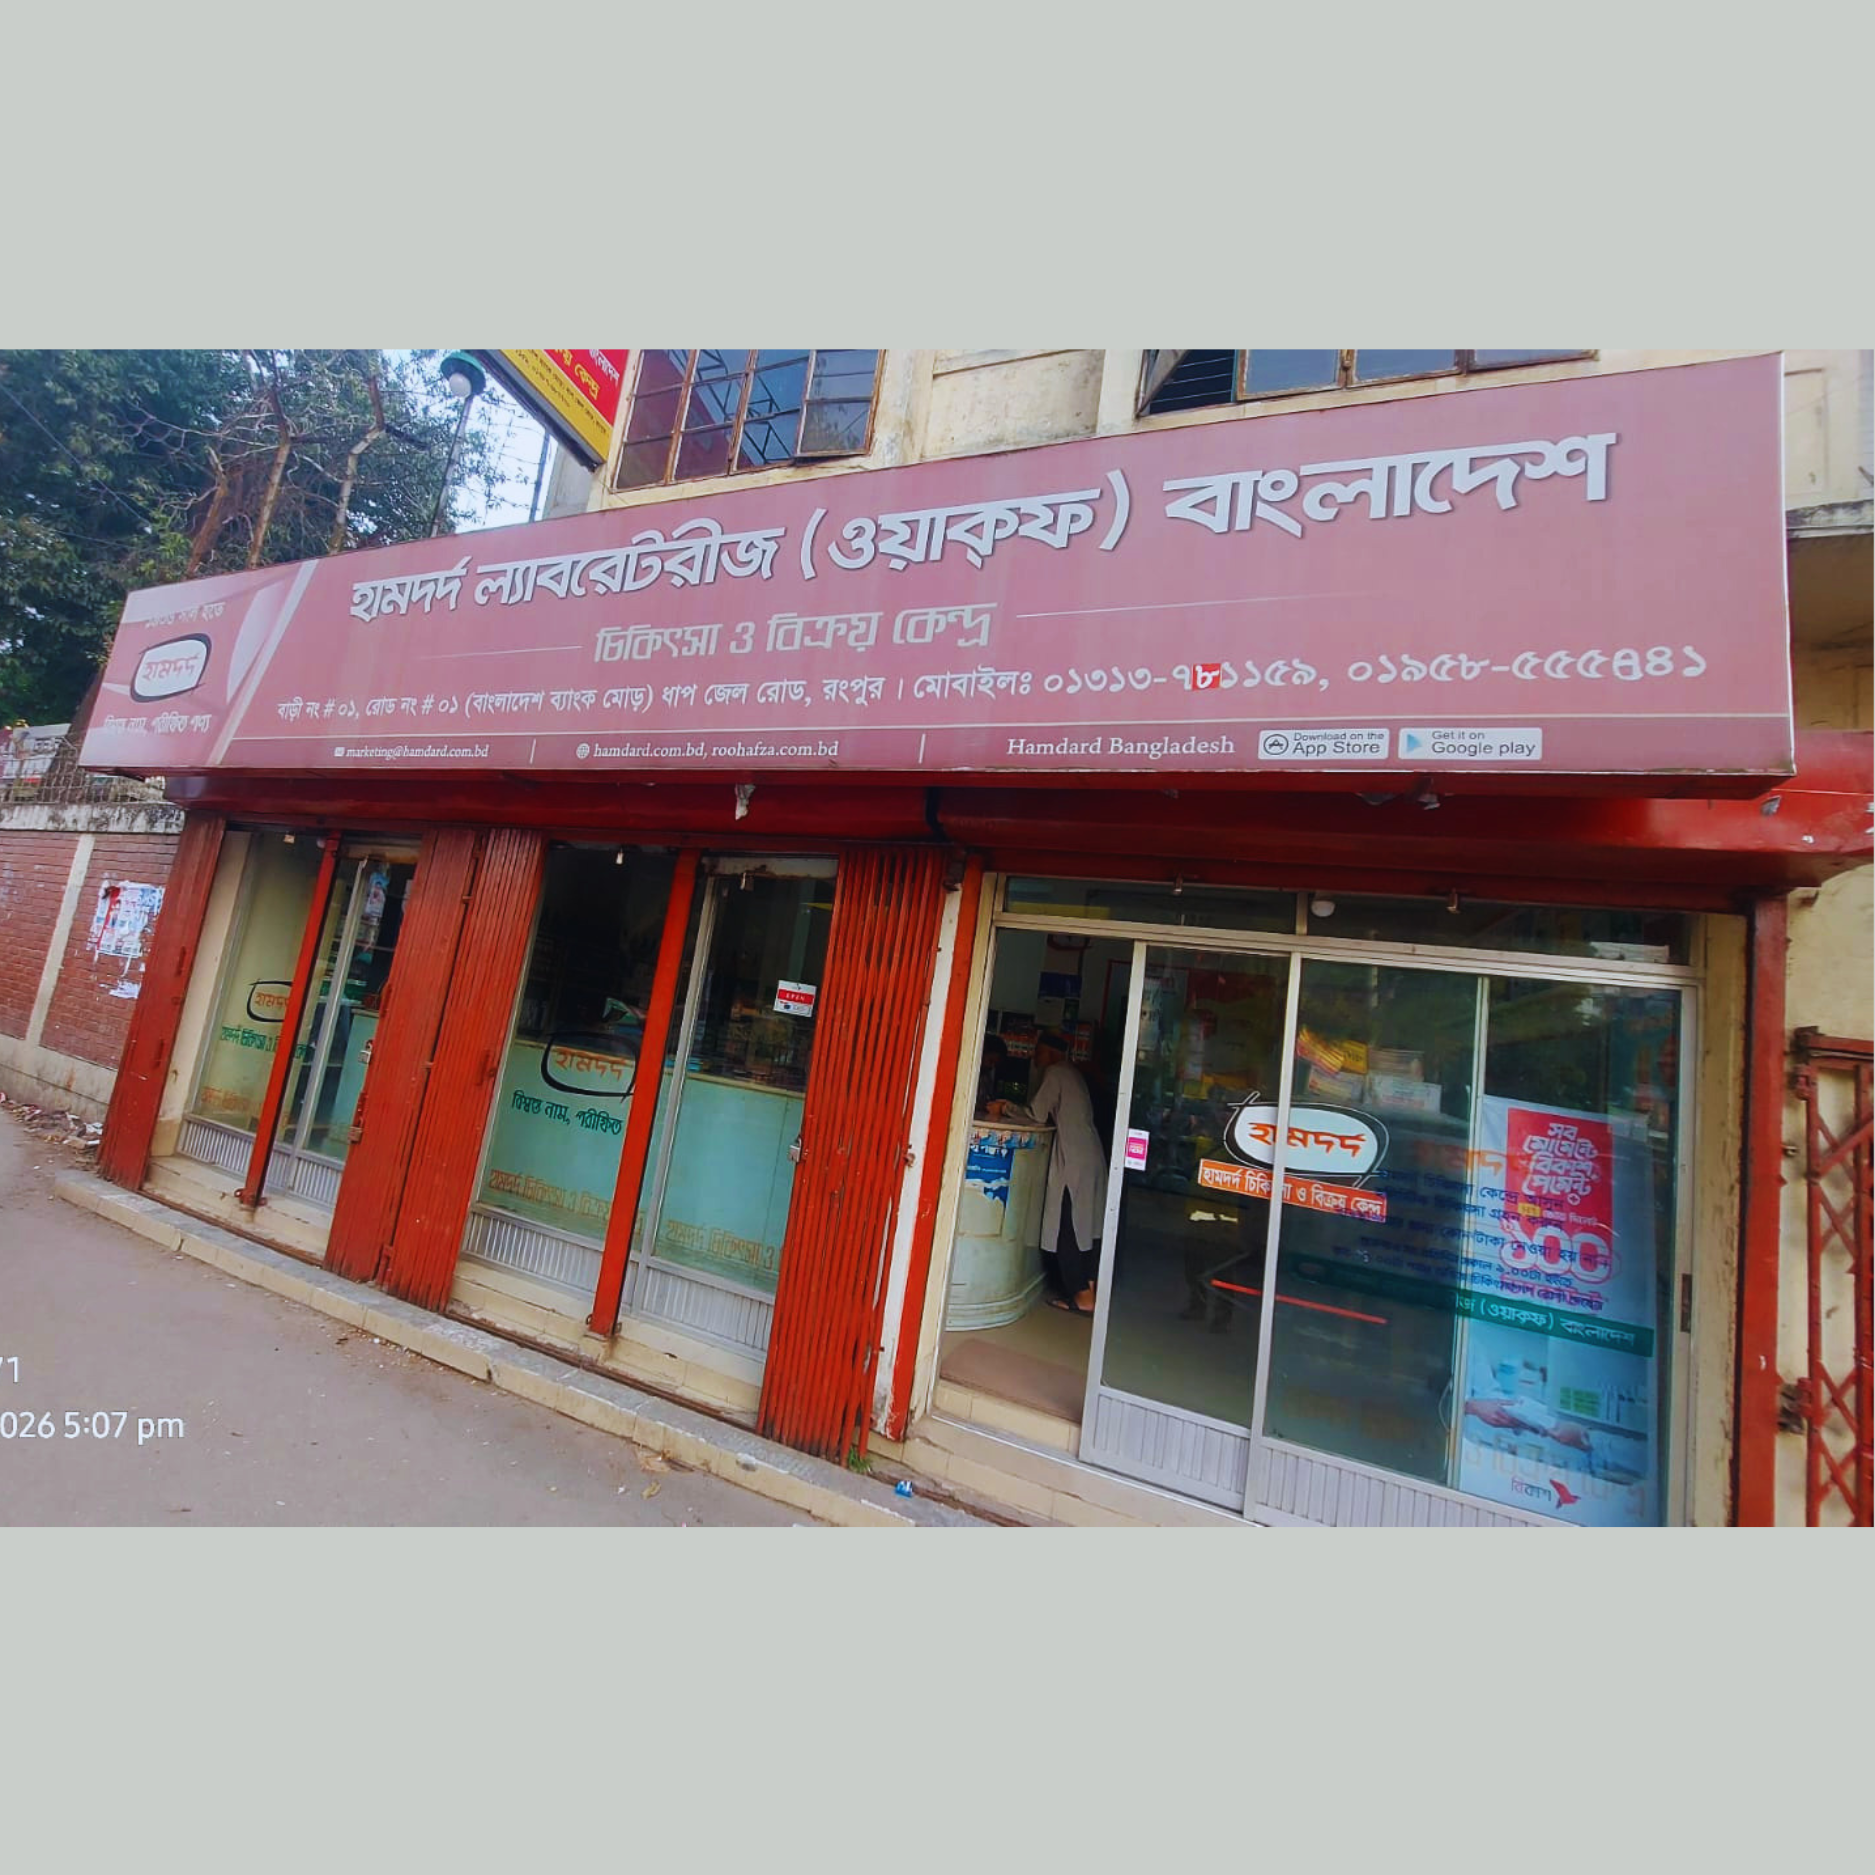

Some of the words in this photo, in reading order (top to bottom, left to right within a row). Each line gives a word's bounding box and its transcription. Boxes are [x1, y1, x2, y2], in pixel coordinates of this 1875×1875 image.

[350, 555, 473, 622] হামদর্দ
[474, 517, 786, 606] ল্যাবরেটরীজ
[1162, 432, 1618, 540] বাংলাদেশ
[594, 623, 723, 663] চিকিৎসা
[729, 621, 756, 654] ও
[766, 612, 884, 653] বিক্রয়
[893, 602, 998, 648] কেন্দ্র
[277, 696, 303, 722] বাড়ী
[305, 701, 320, 720] নং
[323, 698, 335, 719] #
[338, 701, 360, 720] ০১,
[365, 697, 398, 717] রোড
[400, 696, 417, 717] নং
[421, 694, 435, 716] #
[438, 695, 459, 715] ০১
[464, 690, 545, 718] (বাংলাদেশ
[550, 688, 598, 713] ব্যাংক
[602, 684, 653, 714] মোড়)
[662, 683, 697, 709] ধাপ
[704, 683, 750, 706] জেল
[757, 678, 811, 707] রোড,
[822, 674, 886, 707] রংপুর
[1293, 731, 1347, 742] Download
[1350, 733, 1364, 742] on
[1367, 731, 1385, 741] the
[1432, 730, 1453, 741] Get
[1456, 730, 1465, 741] it
[1468, 731, 1486, 741] on
[346, 744, 489, 761] marketing@hamdard.com.bd
[593, 742, 708, 760] hamdard.com.bd,
[712, 740, 839, 758] roohafza.com.bd
[1007, 736, 1102, 755] Hamdard
[1109, 736, 1235, 760] Bangladesh
[1292, 741, 1328, 757] App
[1332, 740, 1381, 755] Store
[1431, 740, 1494, 757] Google
[1498, 741, 1537, 757] play
[554, 1047, 629, 1080] হামদর্দ
[575, 1108, 623, 1135] পরীক্ষিত
[1547, 1122, 1578, 1141] সব
[1202, 1167, 1245, 1188] হামদর্দ
[1295, 1186, 1307, 1202] ও
[1311, 1183, 1348, 1209] বিক্রয়
[1560, 1317, 1636, 1347] বাংলাদেশ
[1511, 1477, 1552, 1502] বিকাশ
